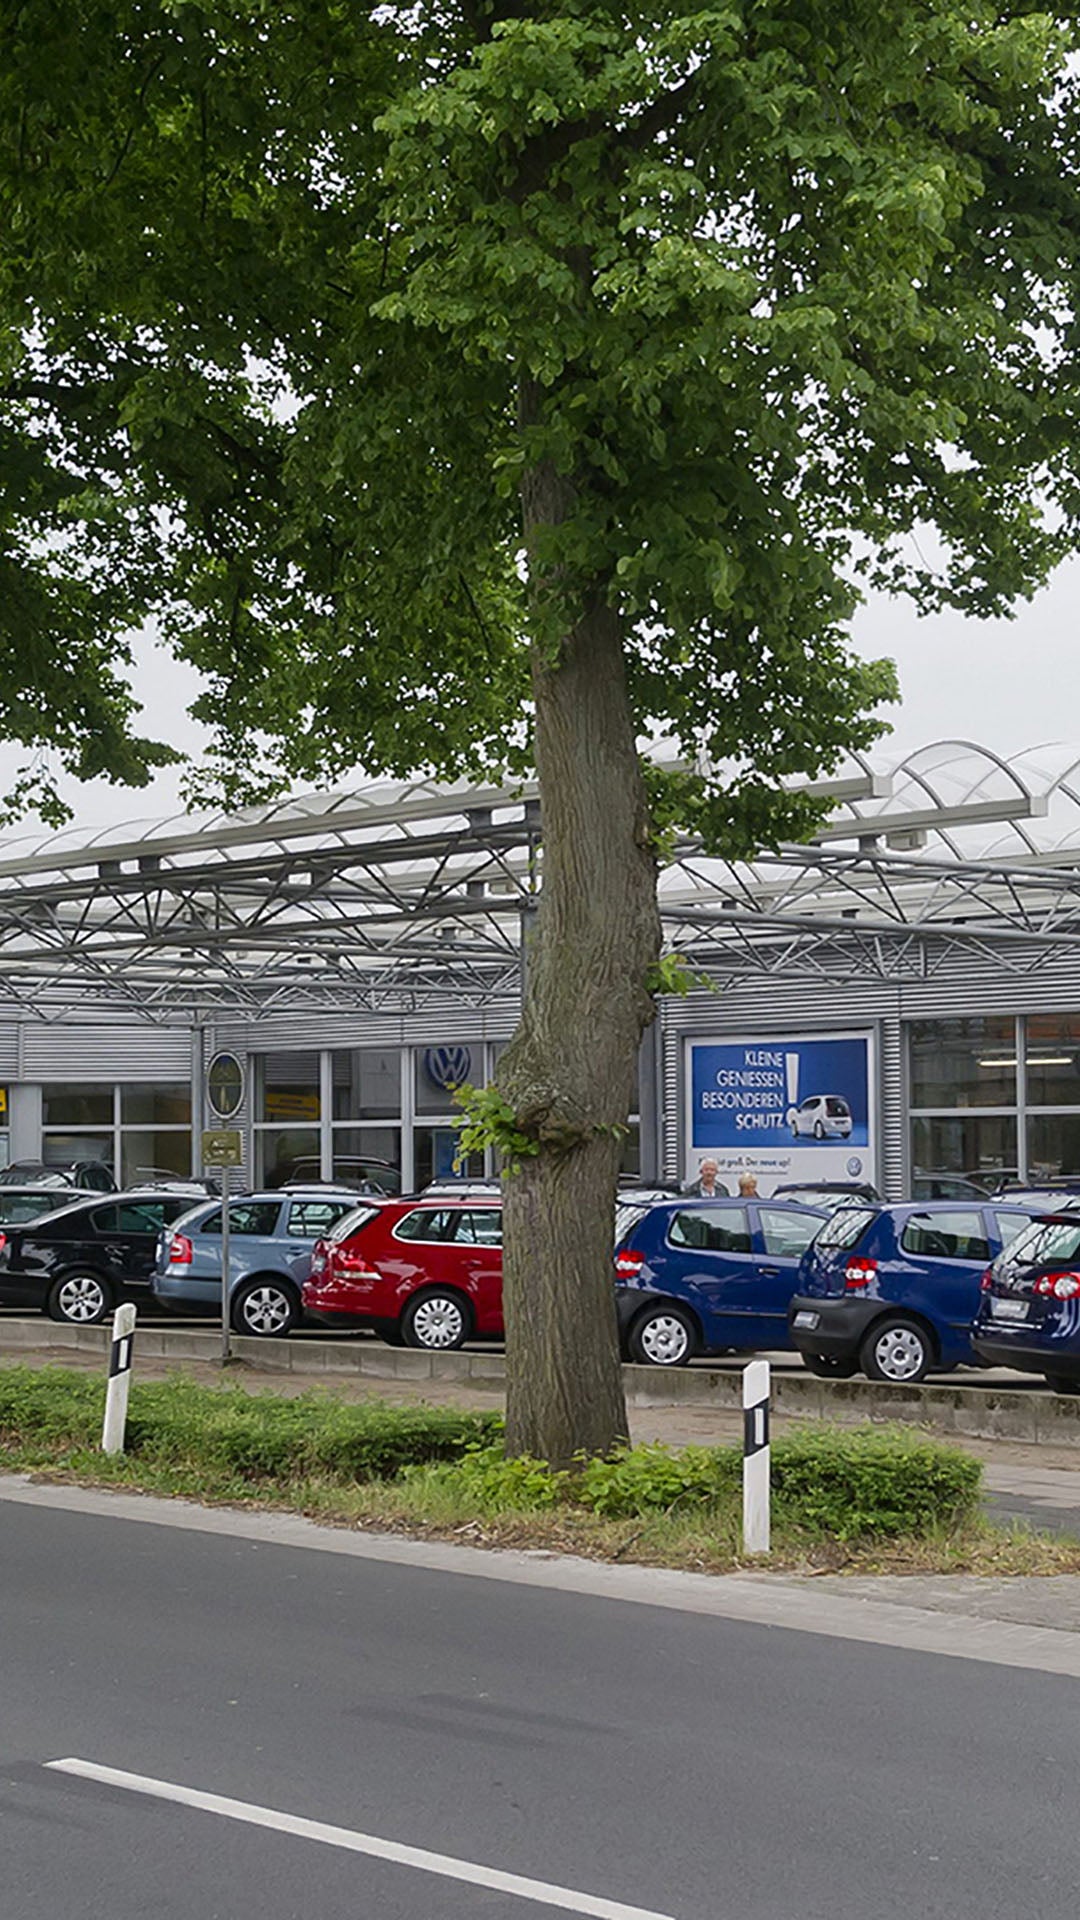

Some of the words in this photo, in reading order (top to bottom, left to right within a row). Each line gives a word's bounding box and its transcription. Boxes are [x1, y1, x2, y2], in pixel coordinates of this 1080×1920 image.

[426, 1046, 471, 1084] VW
[745, 1050, 783, 1068] KLEINE
[717, 1070, 784, 1087] GENIESSEN
[702, 1092, 784, 1109] BESONDEREN
[735, 1113, 785, 1130] SCHUTZ
